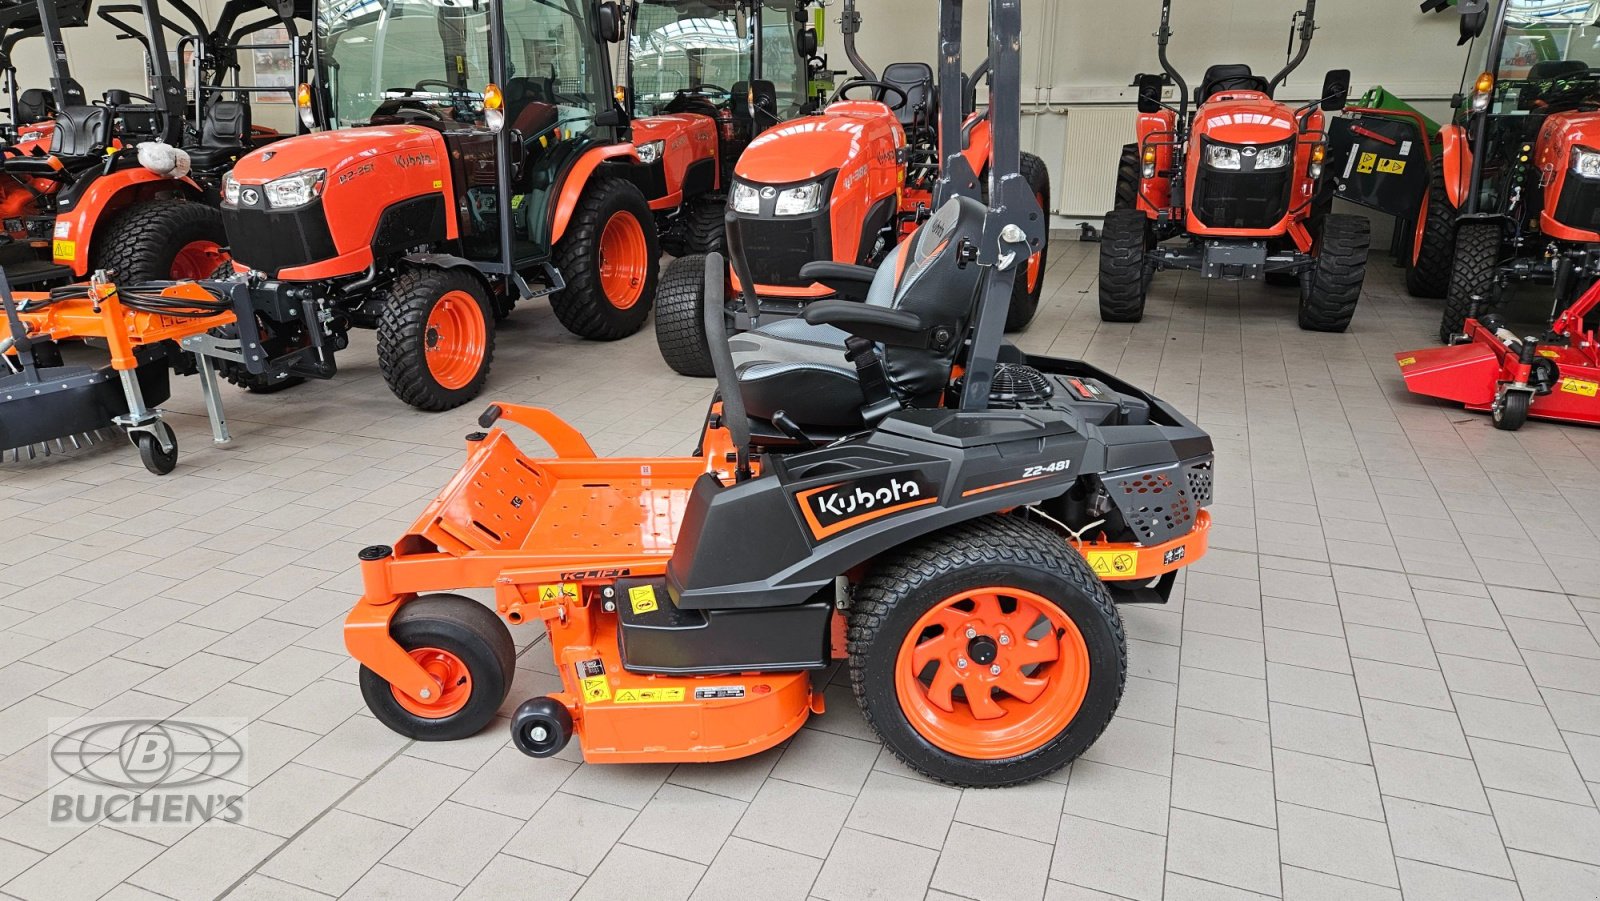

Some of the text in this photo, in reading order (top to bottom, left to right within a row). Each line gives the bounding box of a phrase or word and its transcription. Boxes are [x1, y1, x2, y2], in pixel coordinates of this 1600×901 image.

[395, 153, 432, 168] Kubota
[1022, 459, 1071, 478] Z2-481
[818, 478, 920, 516] Kubota
[563, 568, 629, 580] K-LIFT
